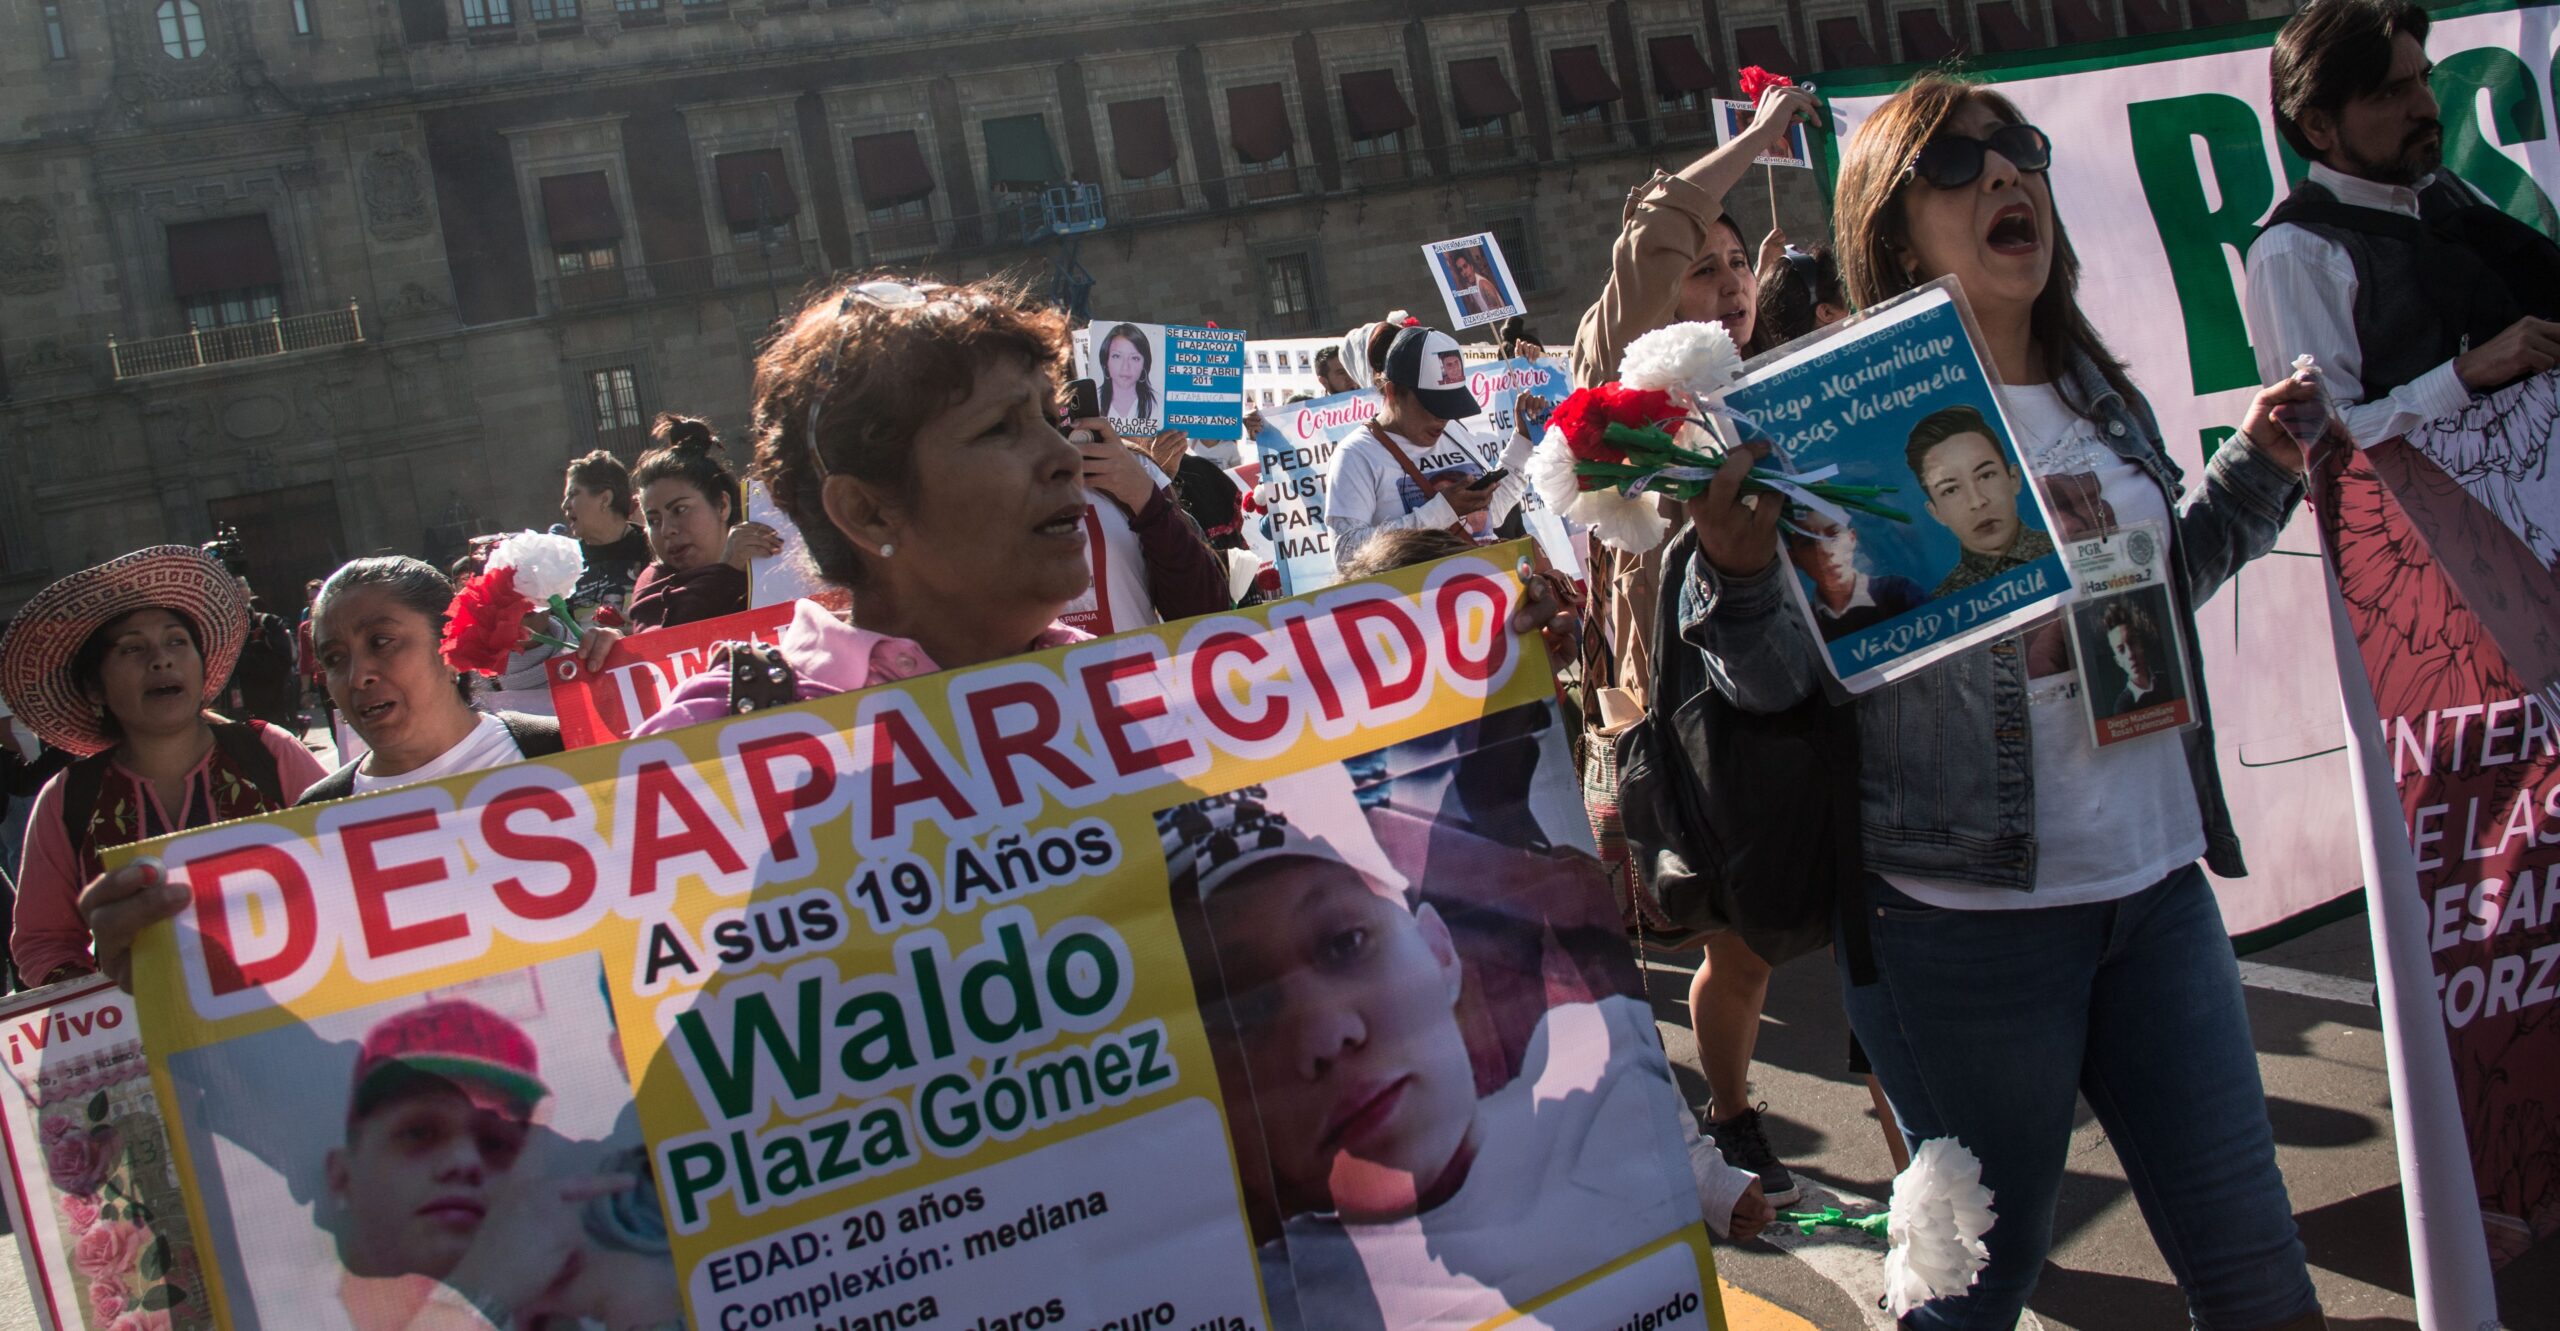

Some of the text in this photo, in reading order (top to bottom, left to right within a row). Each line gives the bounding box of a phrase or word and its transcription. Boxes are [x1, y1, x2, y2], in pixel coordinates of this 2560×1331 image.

[1167, 328, 1245, 342] SE EXTRAVIO EN
[1178, 341, 1236, 352] TLAPACOYA
[1168, 366, 1239, 377] EL 23 DE ABRIL
[1193, 376, 1213, 385] 2011
[1744, 336, 1954, 439] Diego Maximiliano
[1472, 368, 1549, 408] Guerrero
[1125, 418, 1158, 428] LOPEZ
[1297, 396, 1376, 440] Cornelia
[1773, 364, 1967, 459] Rosas Valenzuela
[1115, 425, 1157, 435] DONADO
[1263, 441, 1339, 475] PEDIM
[1269, 473, 1328, 504] JUST
[1272, 505, 1325, 533] PAR
[1278, 532, 1330, 560] MAD
[2077, 542, 2102, 558] PGR
[1060, 612, 1098, 624] ARMONA
[1852, 614, 1942, 661] VERDAD
[2107, 718, 2129, 730] Diego
[2111, 726, 2134, 738] Rosas
[186, 573, 1508, 996] DESAPARECIDO
[644, 826, 1113, 986] A sus 19 Años
[8, 1005, 123, 1066] ¡Vivo
[677, 922, 1119, 1121] Waldo
[667, 1028, 1171, 1225] Plaza Gómez
[708, 1186, 986, 1293] EDAD: 20 años
[720, 1190, 1109, 1331] Complexión: mediana
